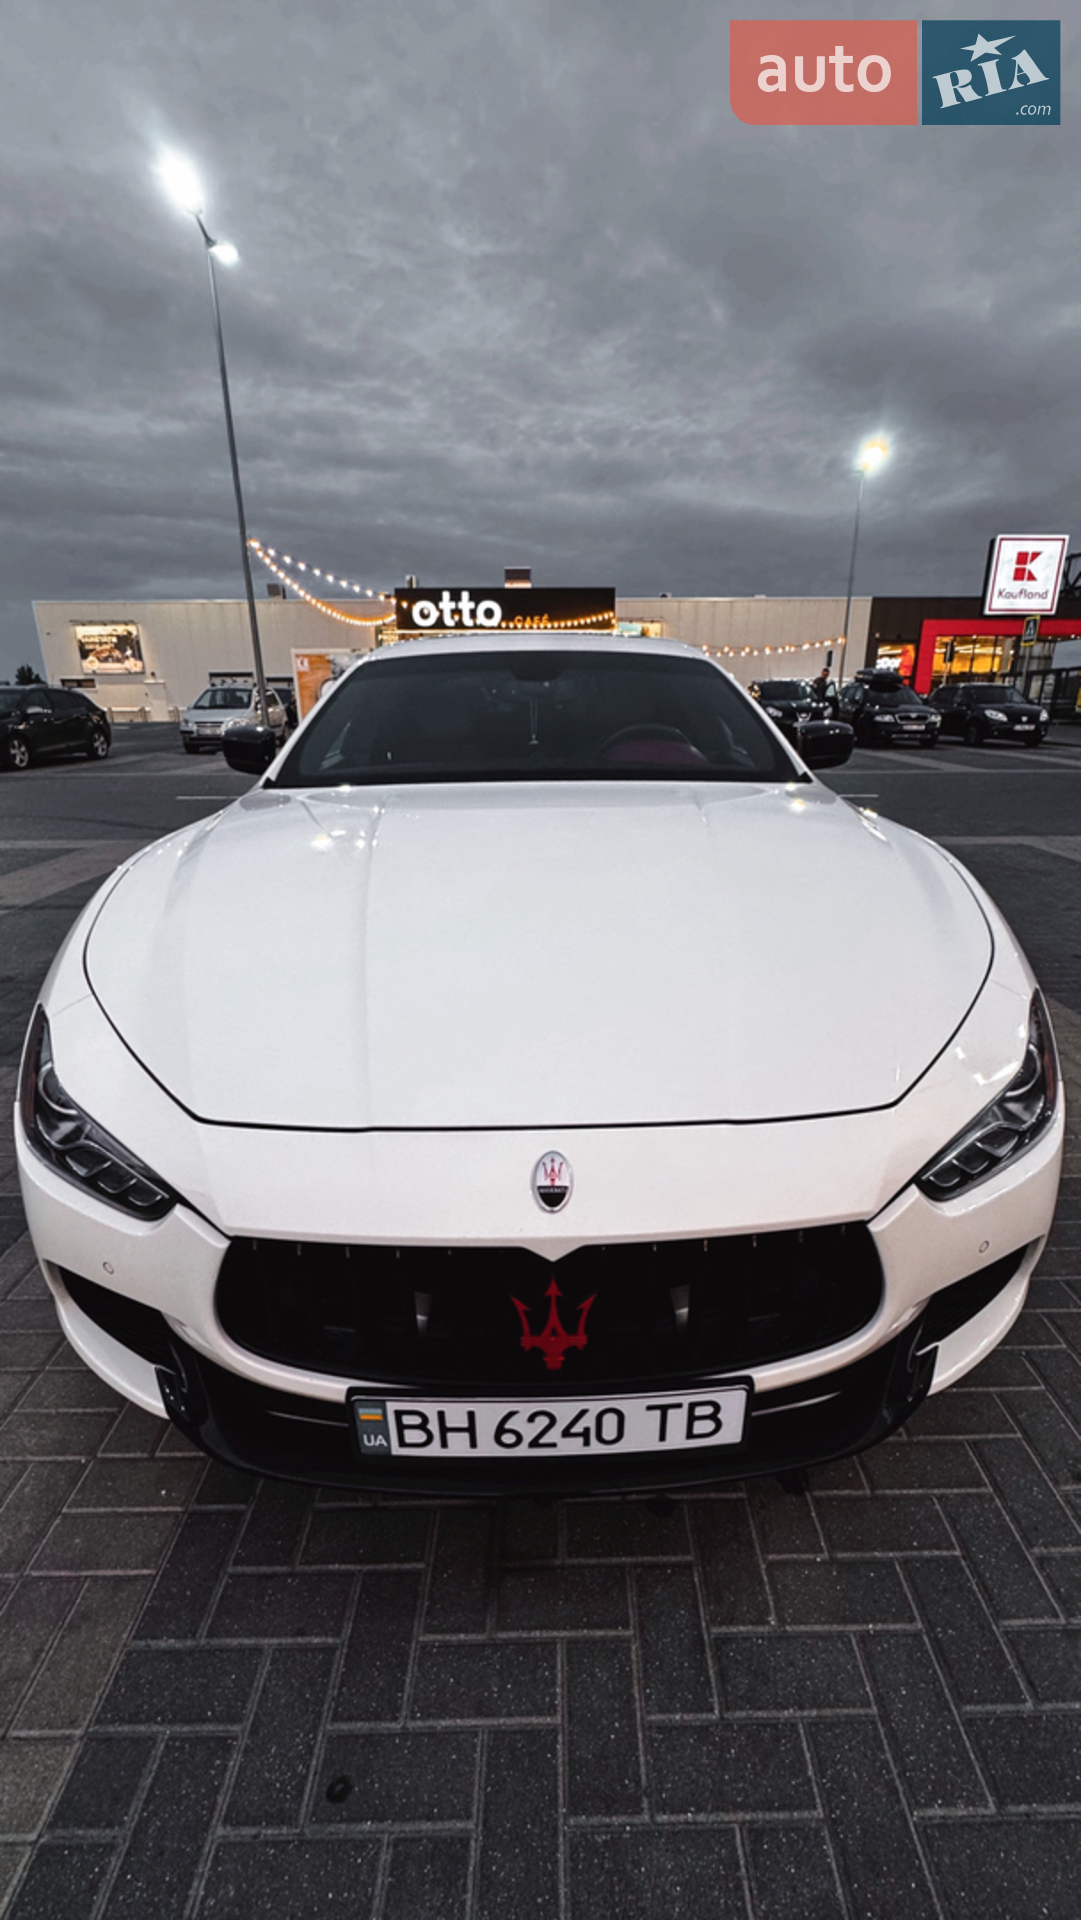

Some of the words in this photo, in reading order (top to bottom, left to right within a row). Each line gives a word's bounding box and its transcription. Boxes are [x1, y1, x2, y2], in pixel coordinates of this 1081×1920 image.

[997, 588, 1049, 600] Kaufland
[412, 590, 502, 627] otto
[393, 1409, 477, 1449] BH
[494, 1407, 625, 1449] 6240
[646, 1400, 723, 1443] TB
[363, 1434, 388, 1447] UA
